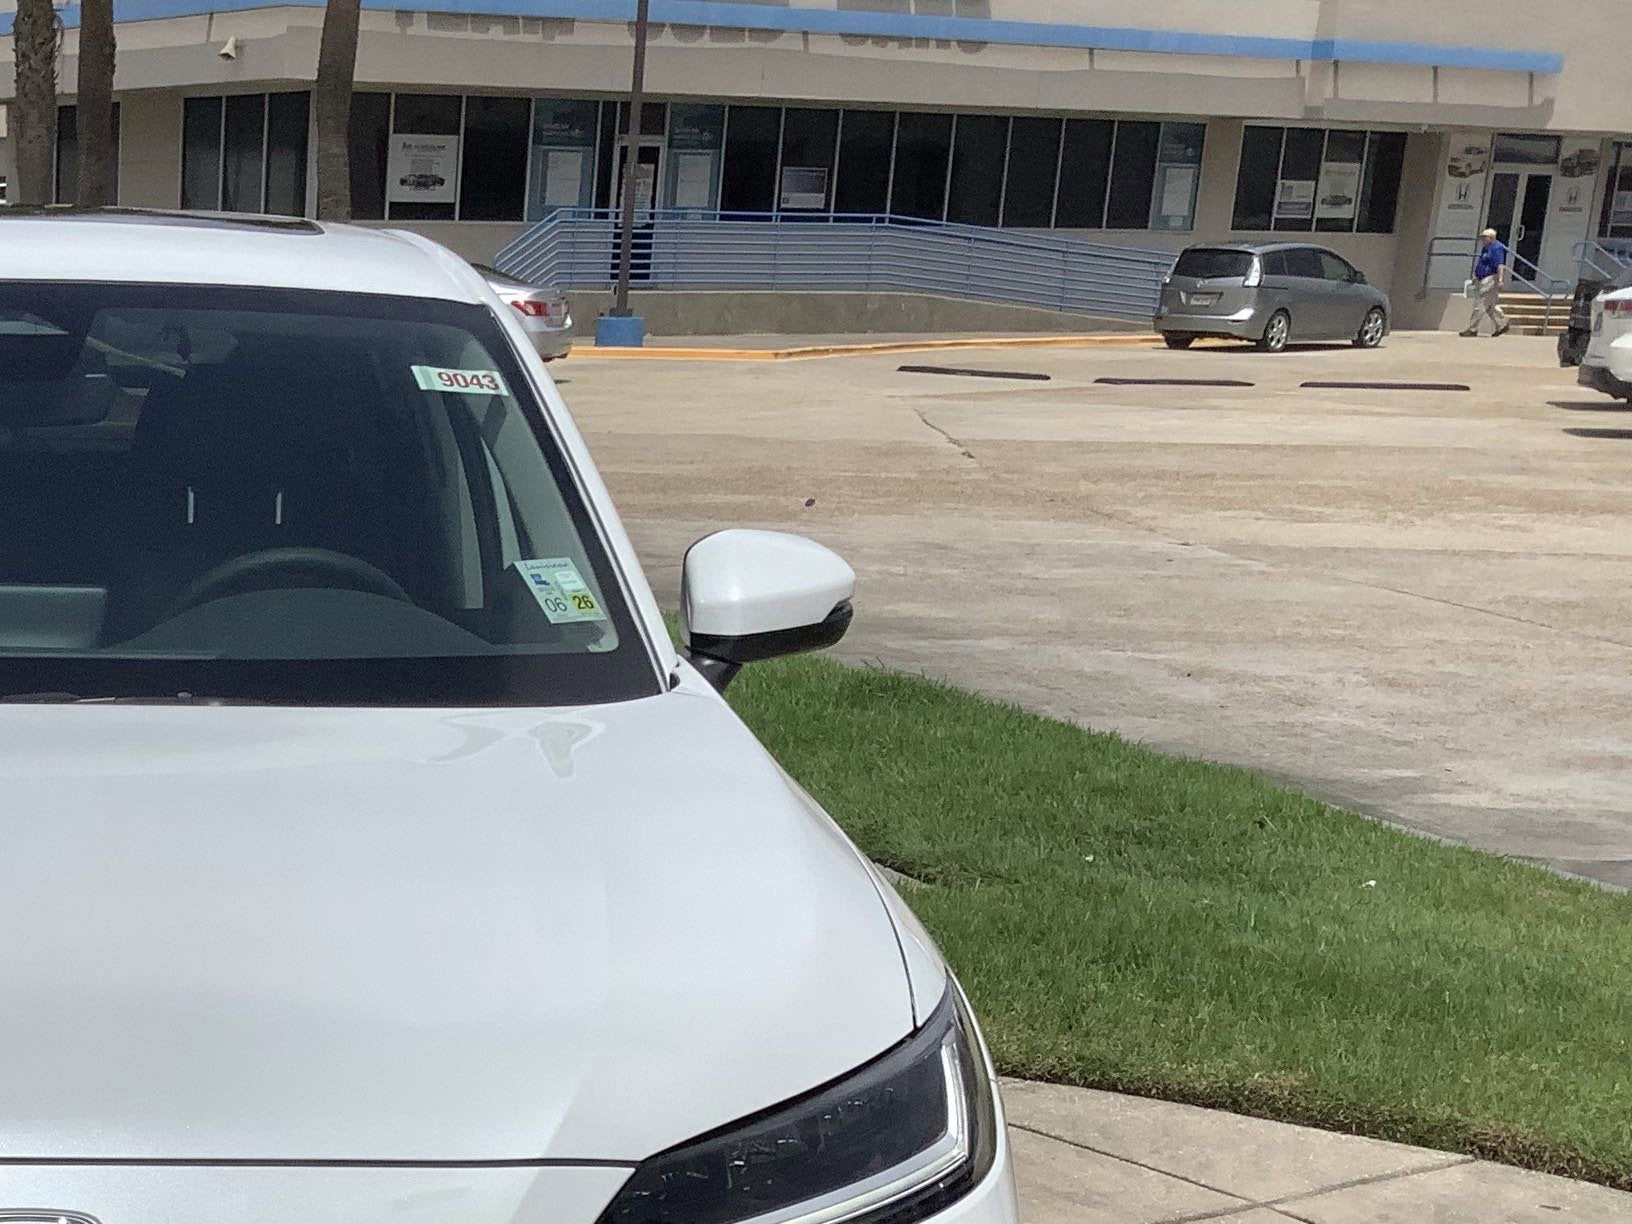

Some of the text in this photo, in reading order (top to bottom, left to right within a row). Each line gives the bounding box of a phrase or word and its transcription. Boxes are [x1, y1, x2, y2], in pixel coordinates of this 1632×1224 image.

[437, 371, 500, 391] 9043
[544, 595, 594, 613] 06 26
